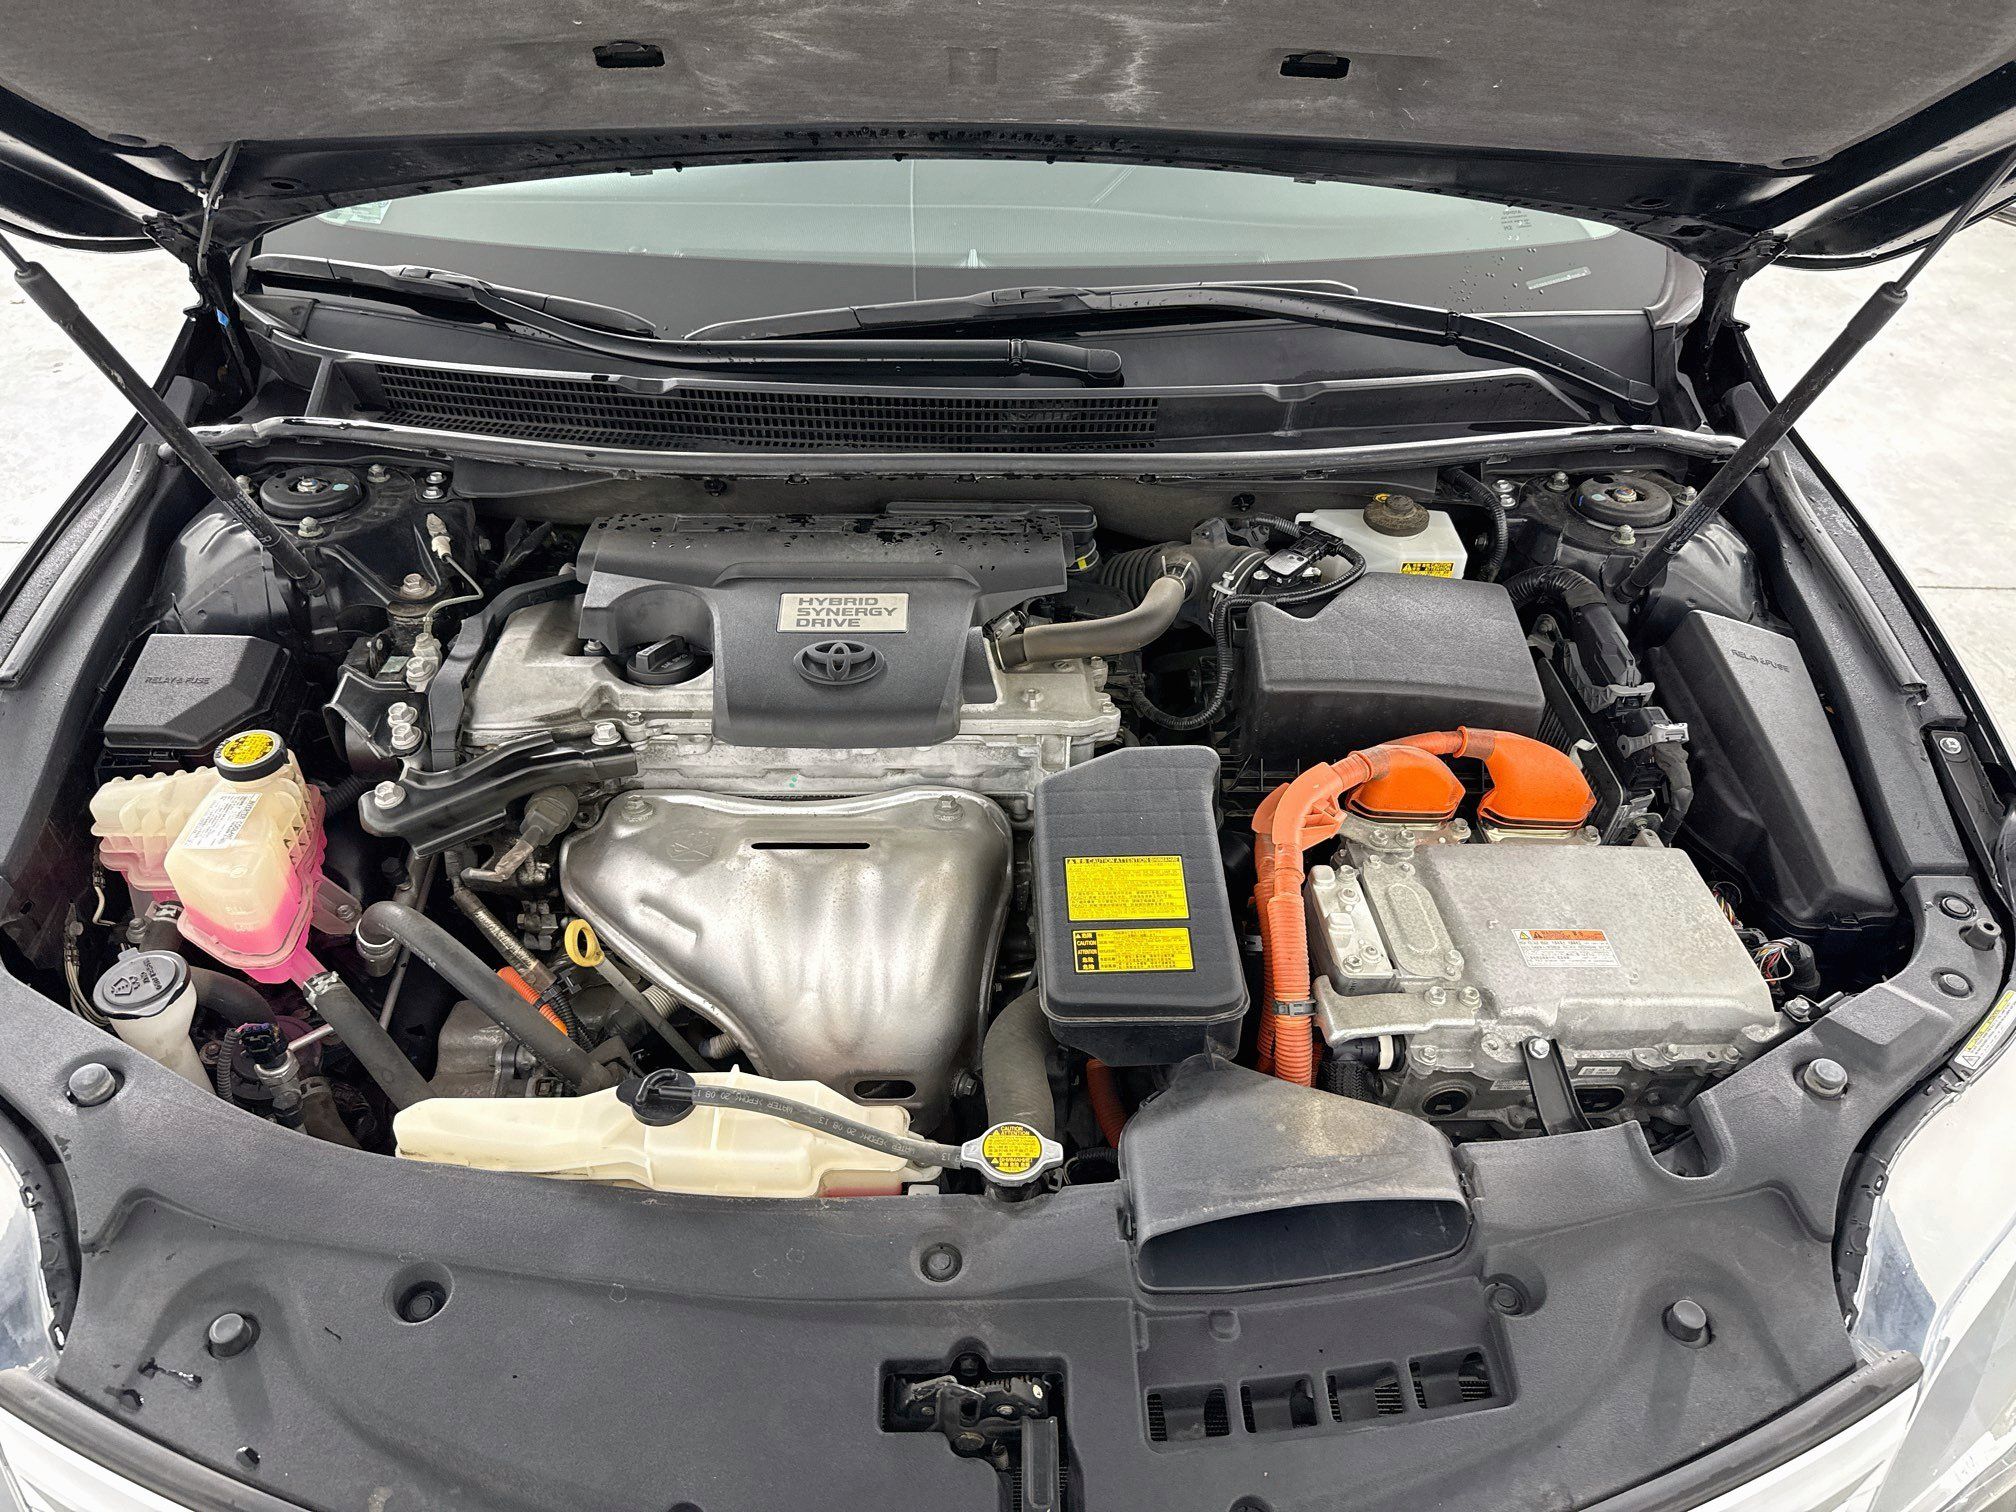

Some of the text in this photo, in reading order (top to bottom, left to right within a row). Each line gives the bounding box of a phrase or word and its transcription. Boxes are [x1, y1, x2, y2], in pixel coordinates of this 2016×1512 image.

[798, 597, 879, 606] HYBRID
[796, 607, 898, 617] SYNERGY
[795, 618, 861, 628] DRIVE
[145, 676, 176, 684] RELAY
[705, 1090, 716, 1098] 08
[767, 1101, 794, 1114] WATER
[818, 1116, 829, 1125] 13
[846, 1127, 857, 1135] 20
[941, 1152, 951, 1161] 13
